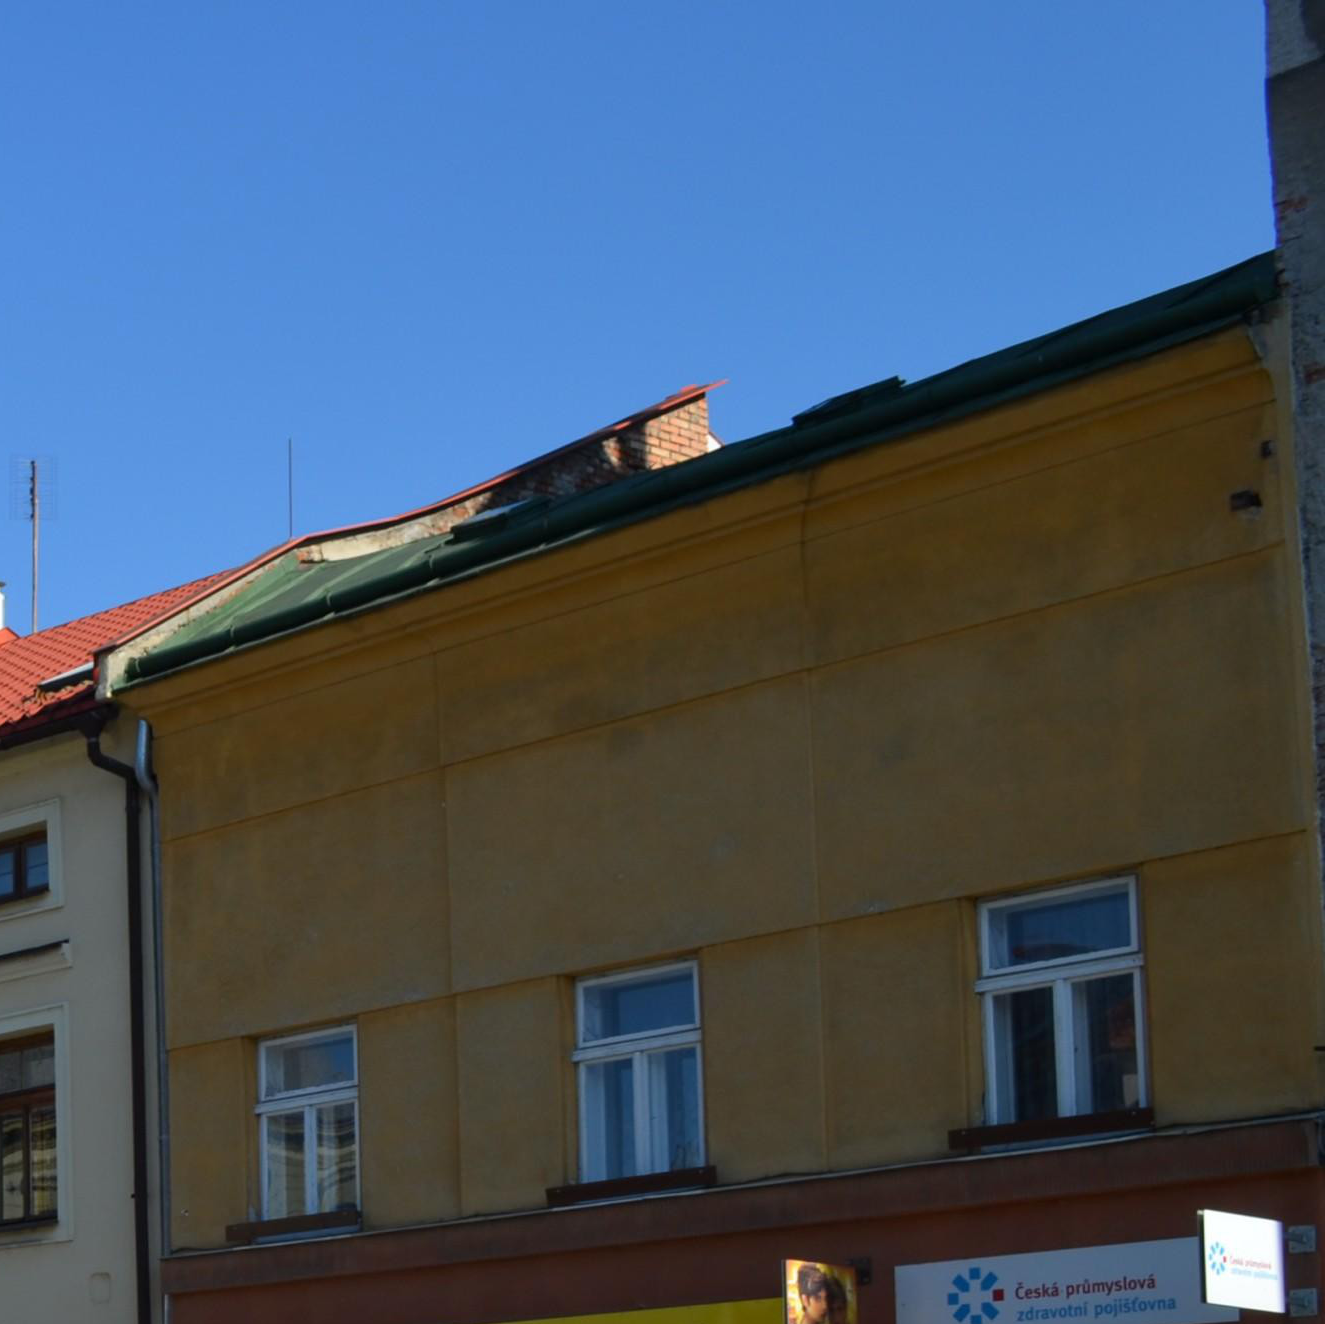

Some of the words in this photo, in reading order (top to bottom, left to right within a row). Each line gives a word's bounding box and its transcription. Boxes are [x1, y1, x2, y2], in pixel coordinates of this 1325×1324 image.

[1015, 1282, 1060, 1301] Česká
[1066, 1274, 1157, 1299] průmyslová
[1017, 1302, 1088, 1322] zdravotní
[1094, 1297, 1177, 1319] pojišťovna
